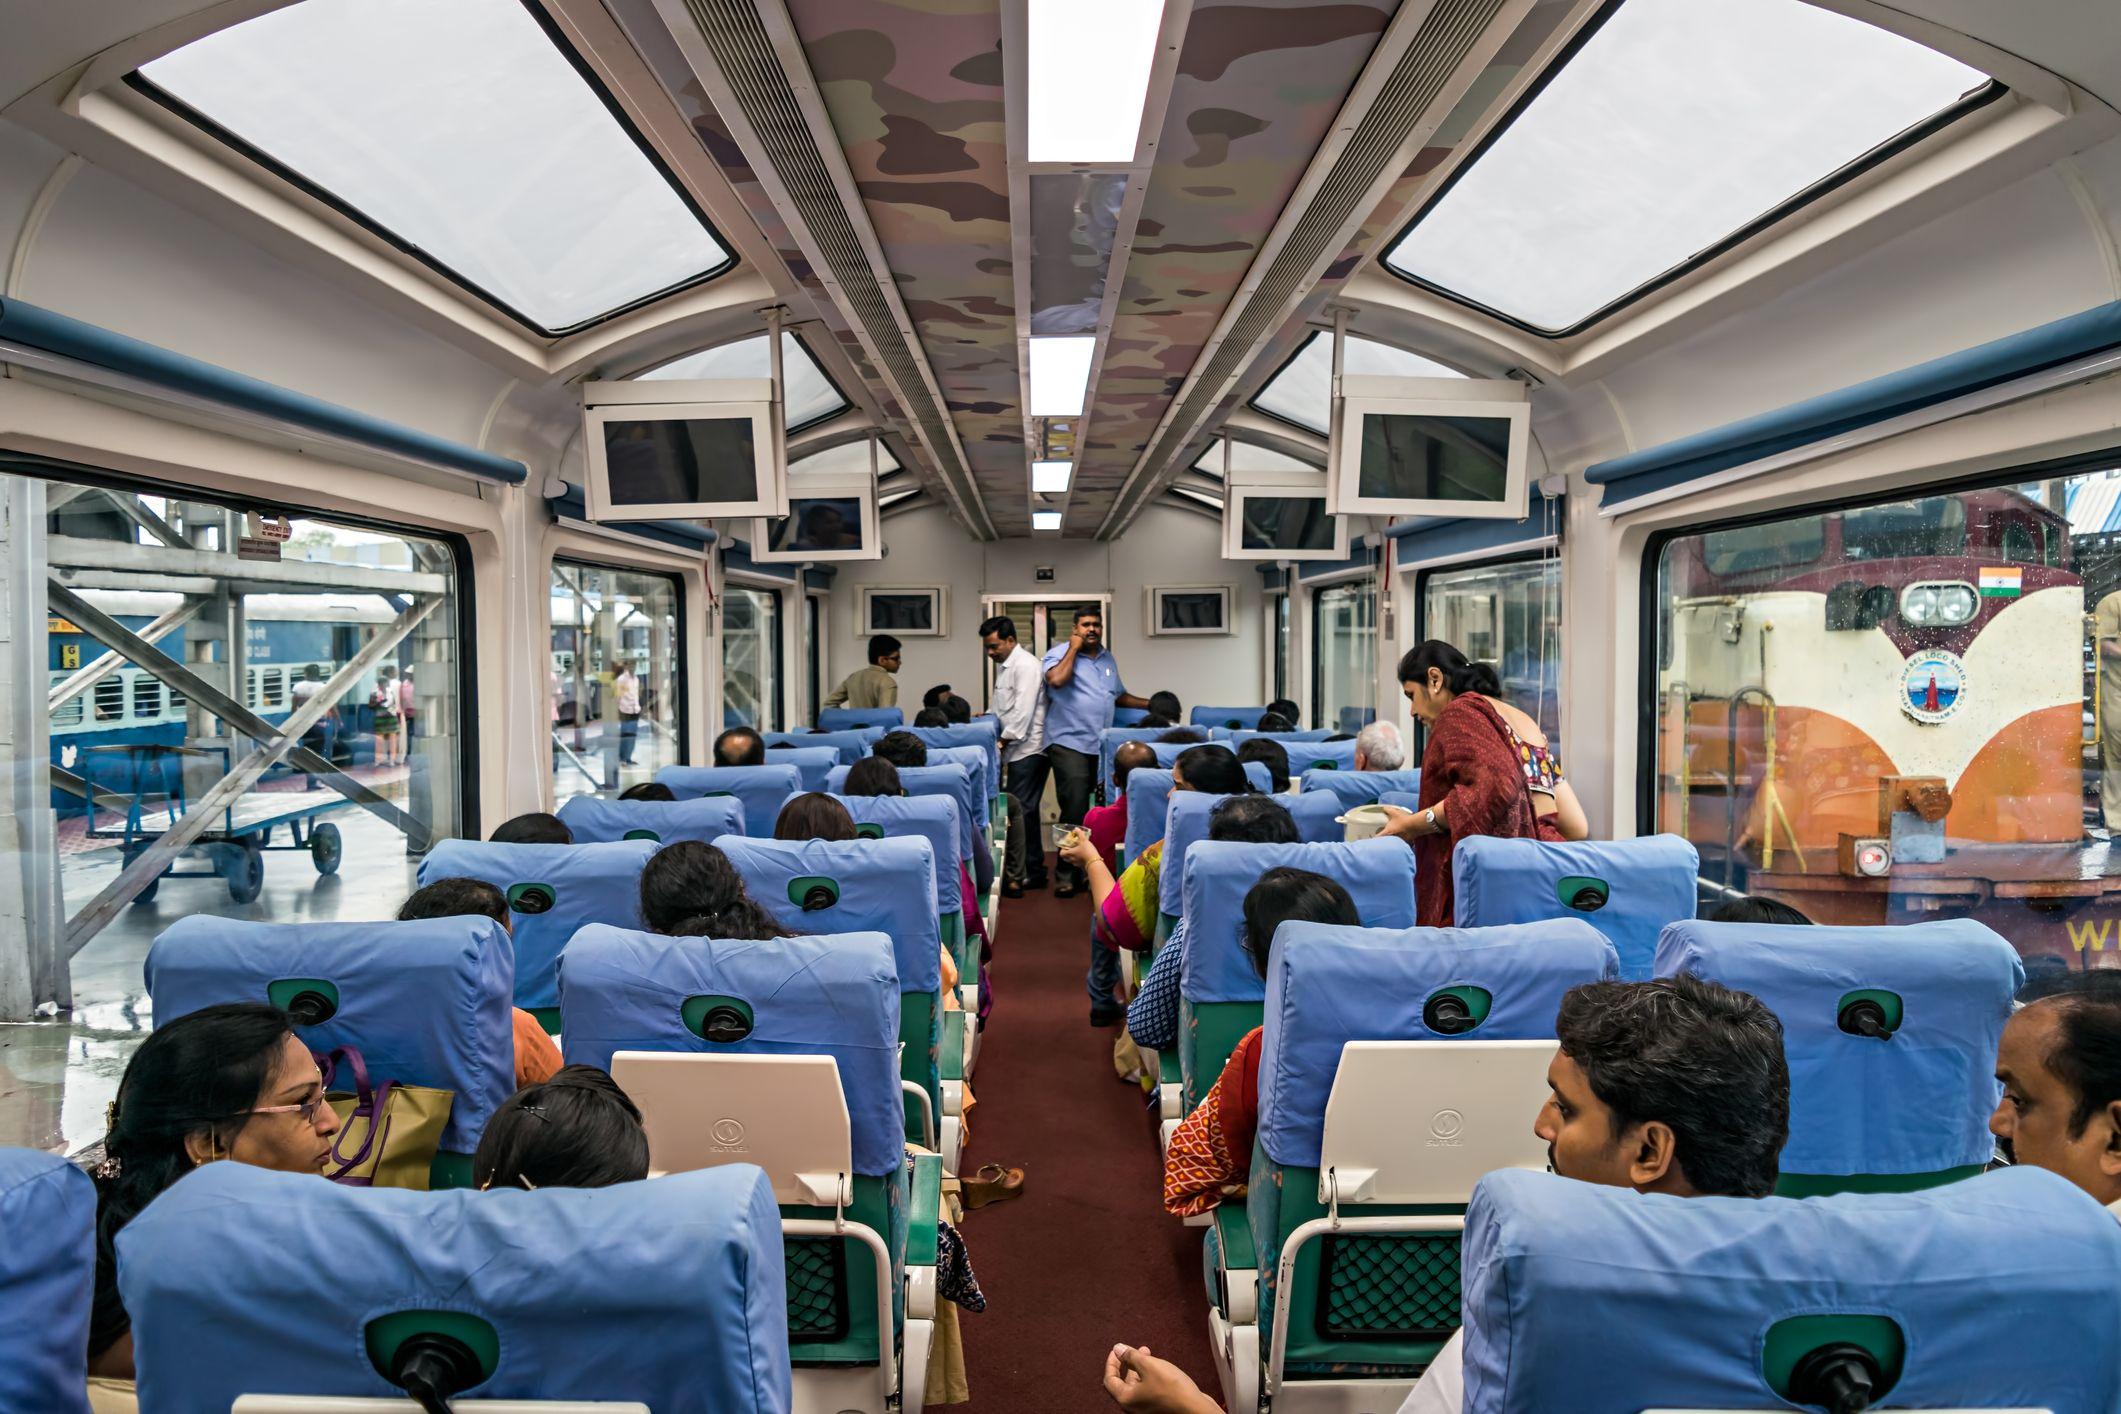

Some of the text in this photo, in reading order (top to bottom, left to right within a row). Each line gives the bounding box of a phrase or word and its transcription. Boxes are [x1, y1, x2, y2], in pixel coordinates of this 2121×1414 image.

[1900, 651, 1967, 681] DIESEL LOCO SHED
[2065, 919, 2121, 951] W
